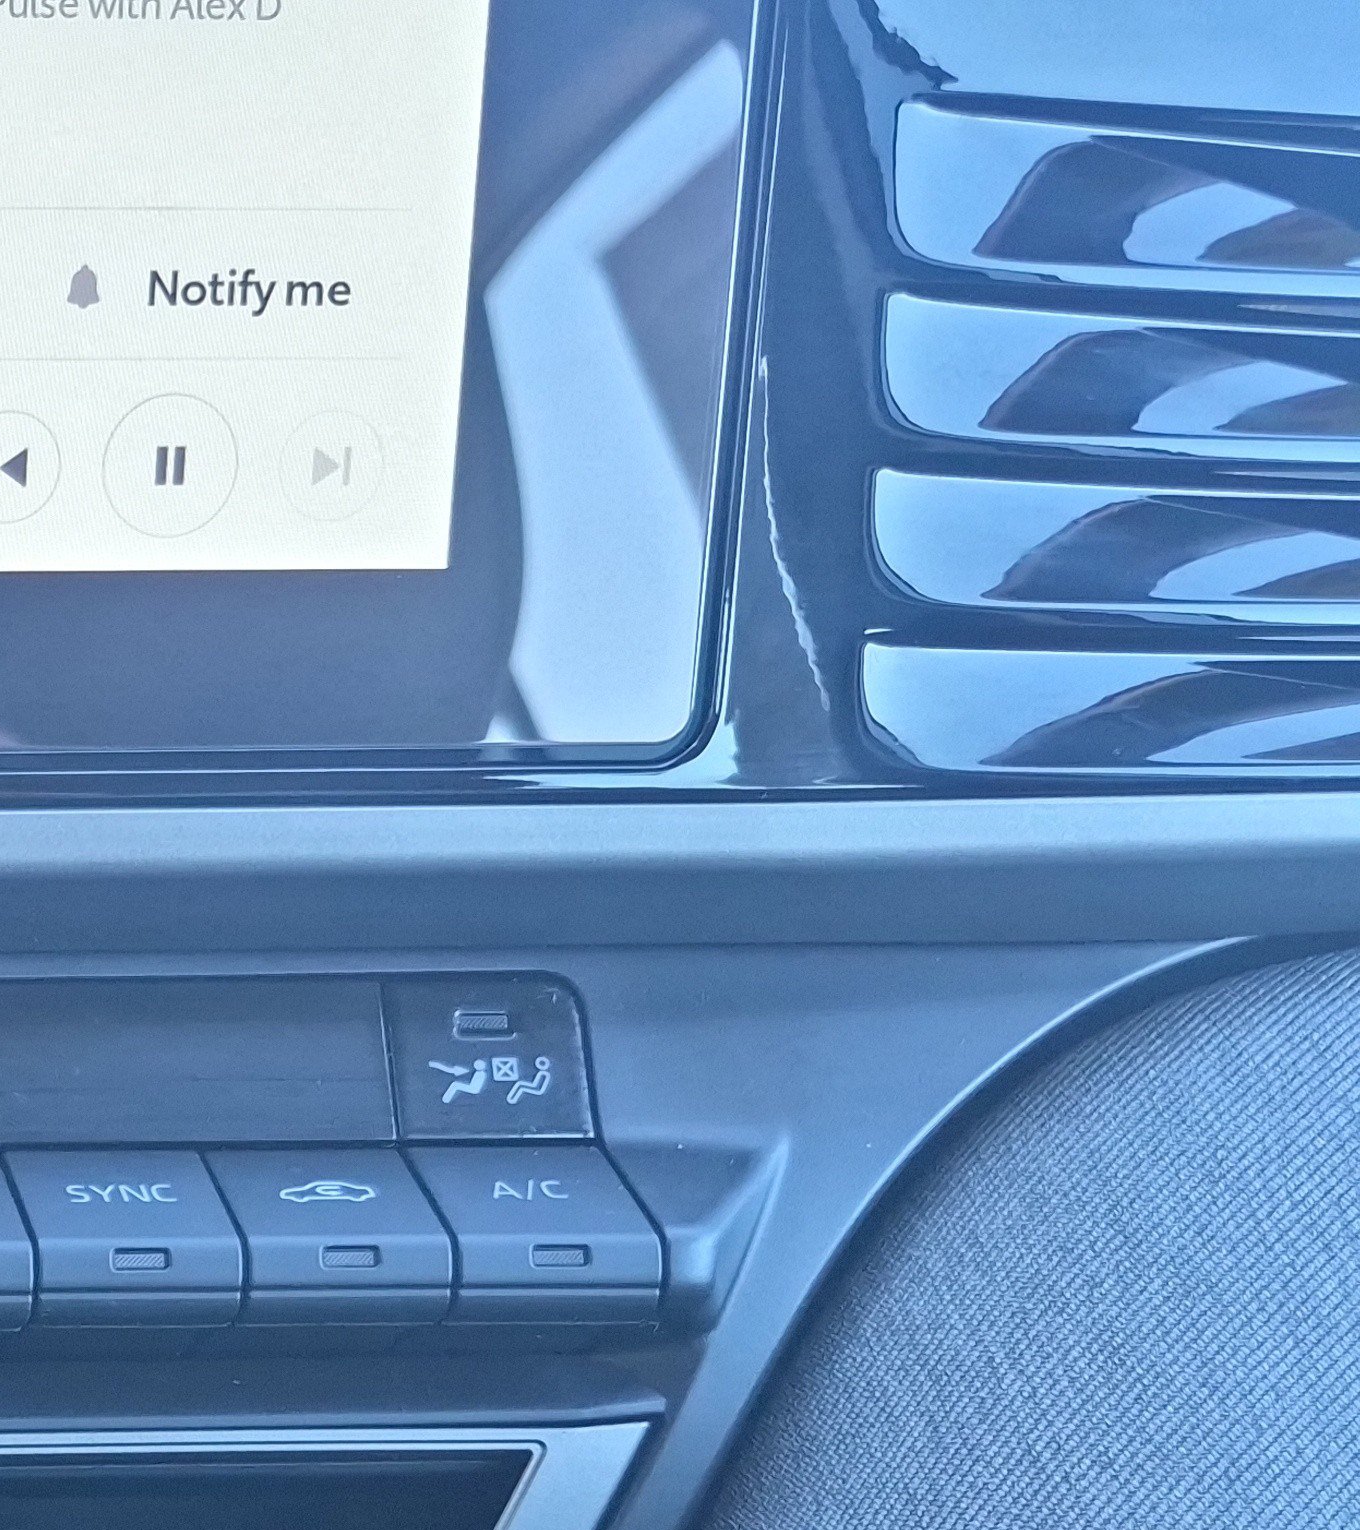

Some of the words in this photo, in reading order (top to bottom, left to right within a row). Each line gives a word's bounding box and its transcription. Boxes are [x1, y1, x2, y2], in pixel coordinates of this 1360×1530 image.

[147, 268, 276, 317] Notify
[285, 281, 352, 307] me
[64, 1183, 179, 1204] SYNC
[492, 1178, 570, 1200] A/C
